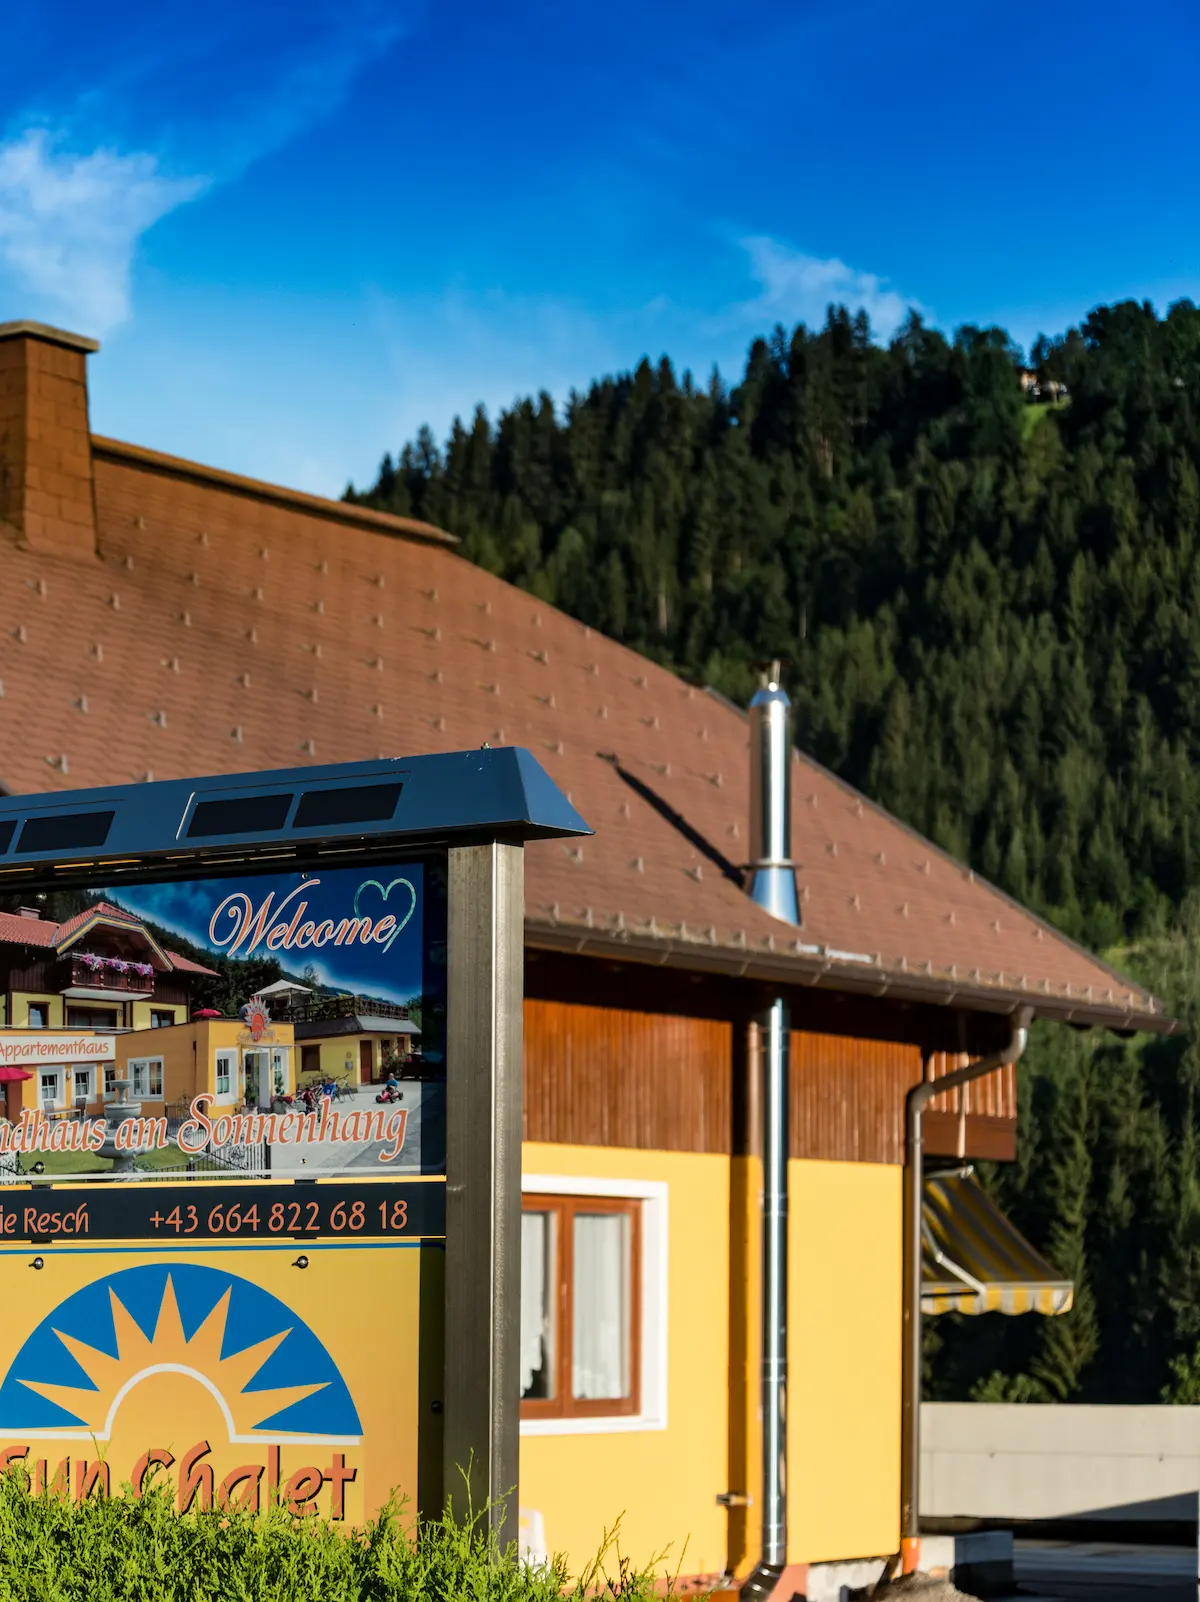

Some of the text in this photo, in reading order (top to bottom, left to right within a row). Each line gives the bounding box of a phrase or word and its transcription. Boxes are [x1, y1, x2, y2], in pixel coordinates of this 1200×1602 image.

[209, 878, 396, 957] Welcome
[114, 1116, 169, 1151] am
[177, 1092, 409, 1162] Sonnenhang
[23, 1202, 89, 1234] Resch
[149, 1200, 409, 1233] +43 664 822 68 18
[131, 1440, 358, 1521] Chalet
